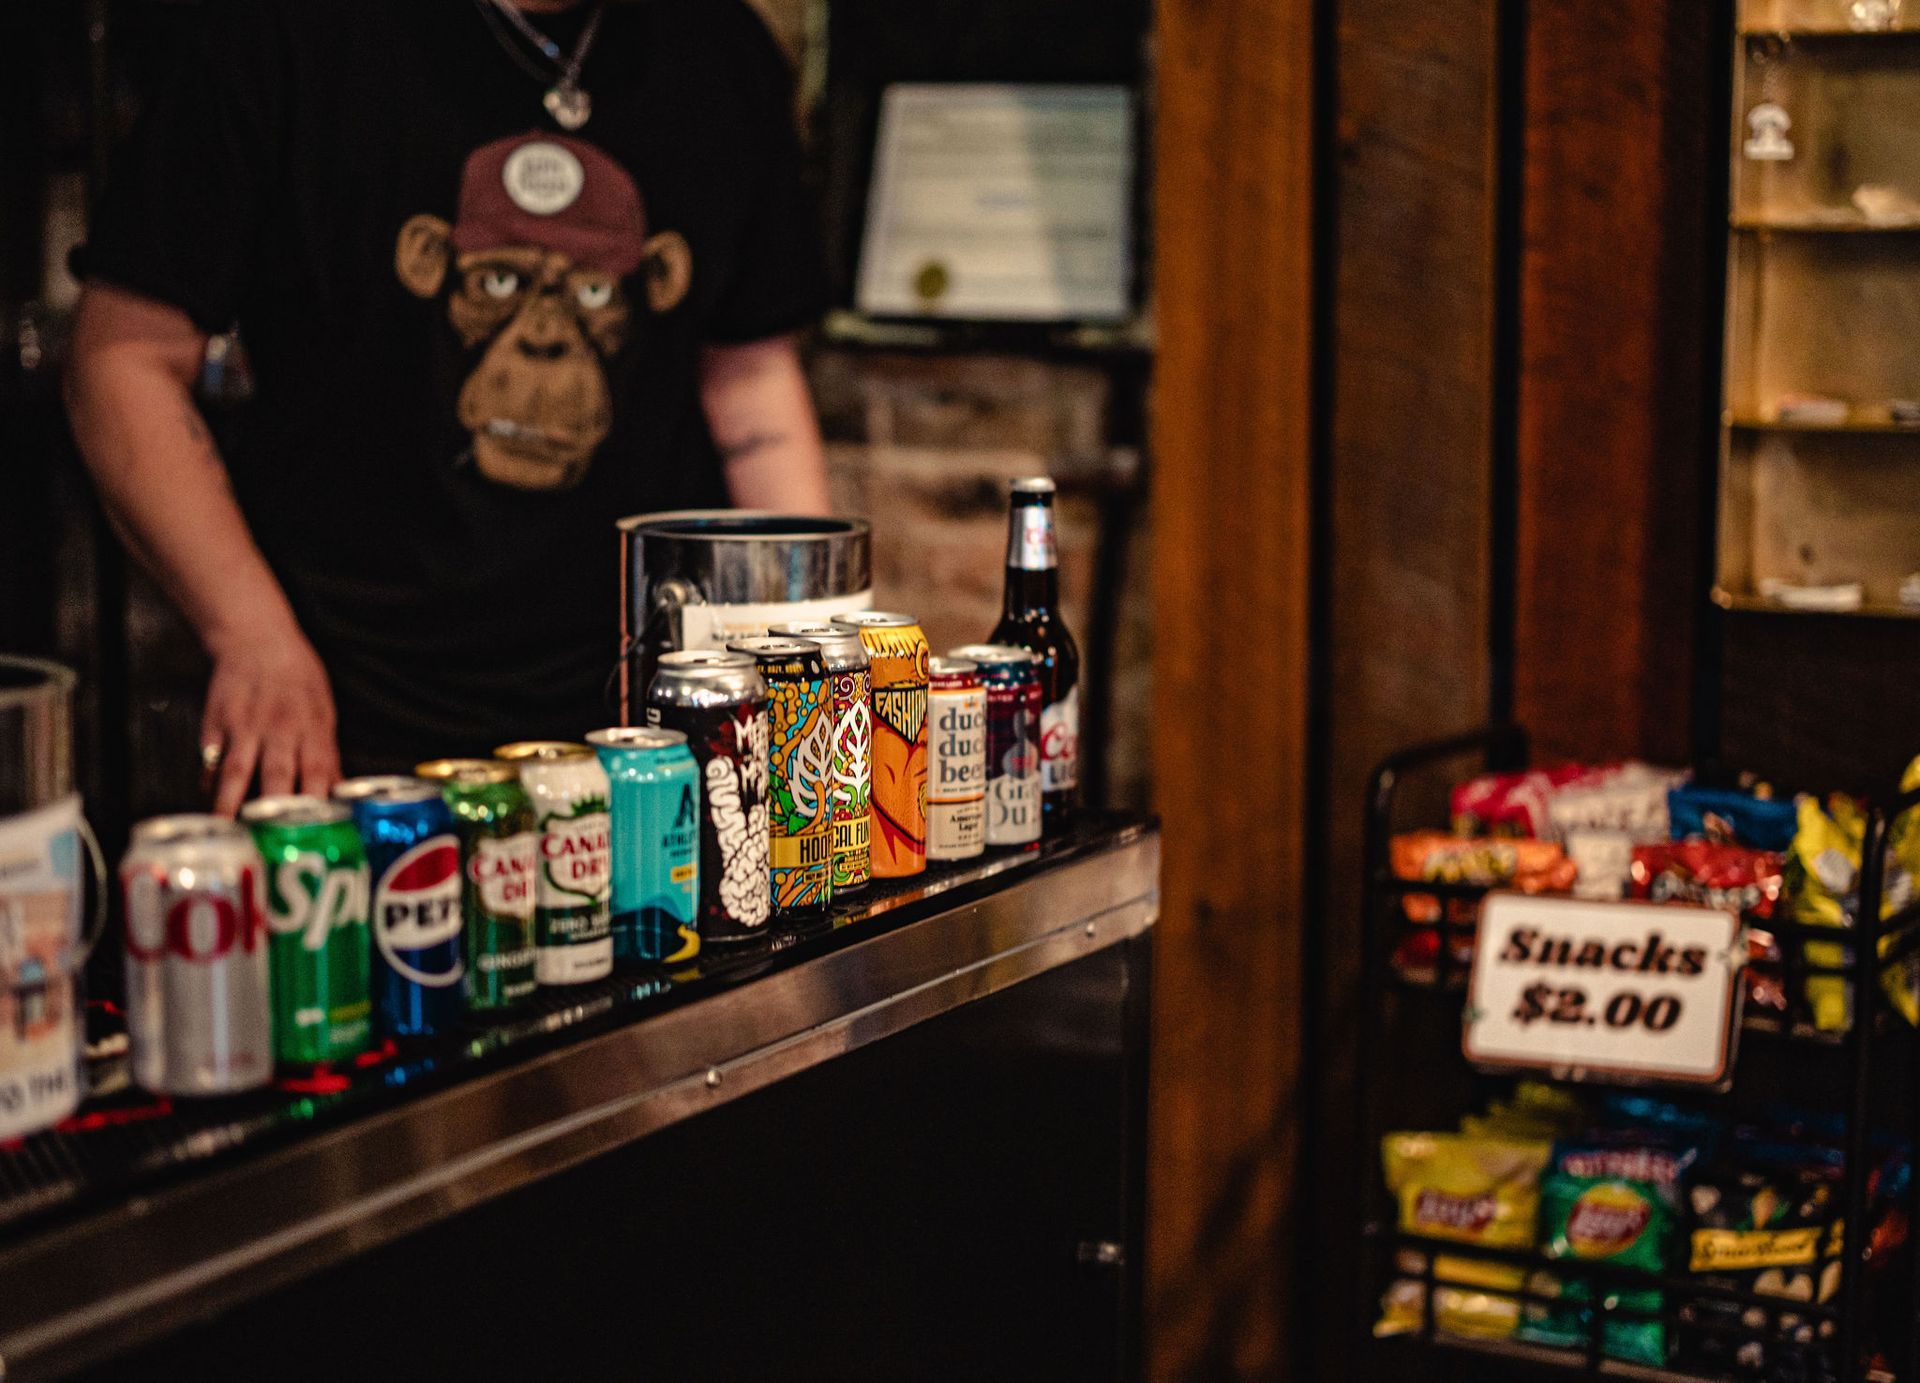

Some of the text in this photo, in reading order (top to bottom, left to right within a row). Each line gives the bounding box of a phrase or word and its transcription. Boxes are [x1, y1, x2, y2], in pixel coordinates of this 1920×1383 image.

[938, 732, 985, 758] duc
[939, 759, 985, 784] bee
[541, 832, 611, 861] CANA
[1500, 926, 1706, 977] Snacks
[1513, 983, 1683, 1031] $2.00
